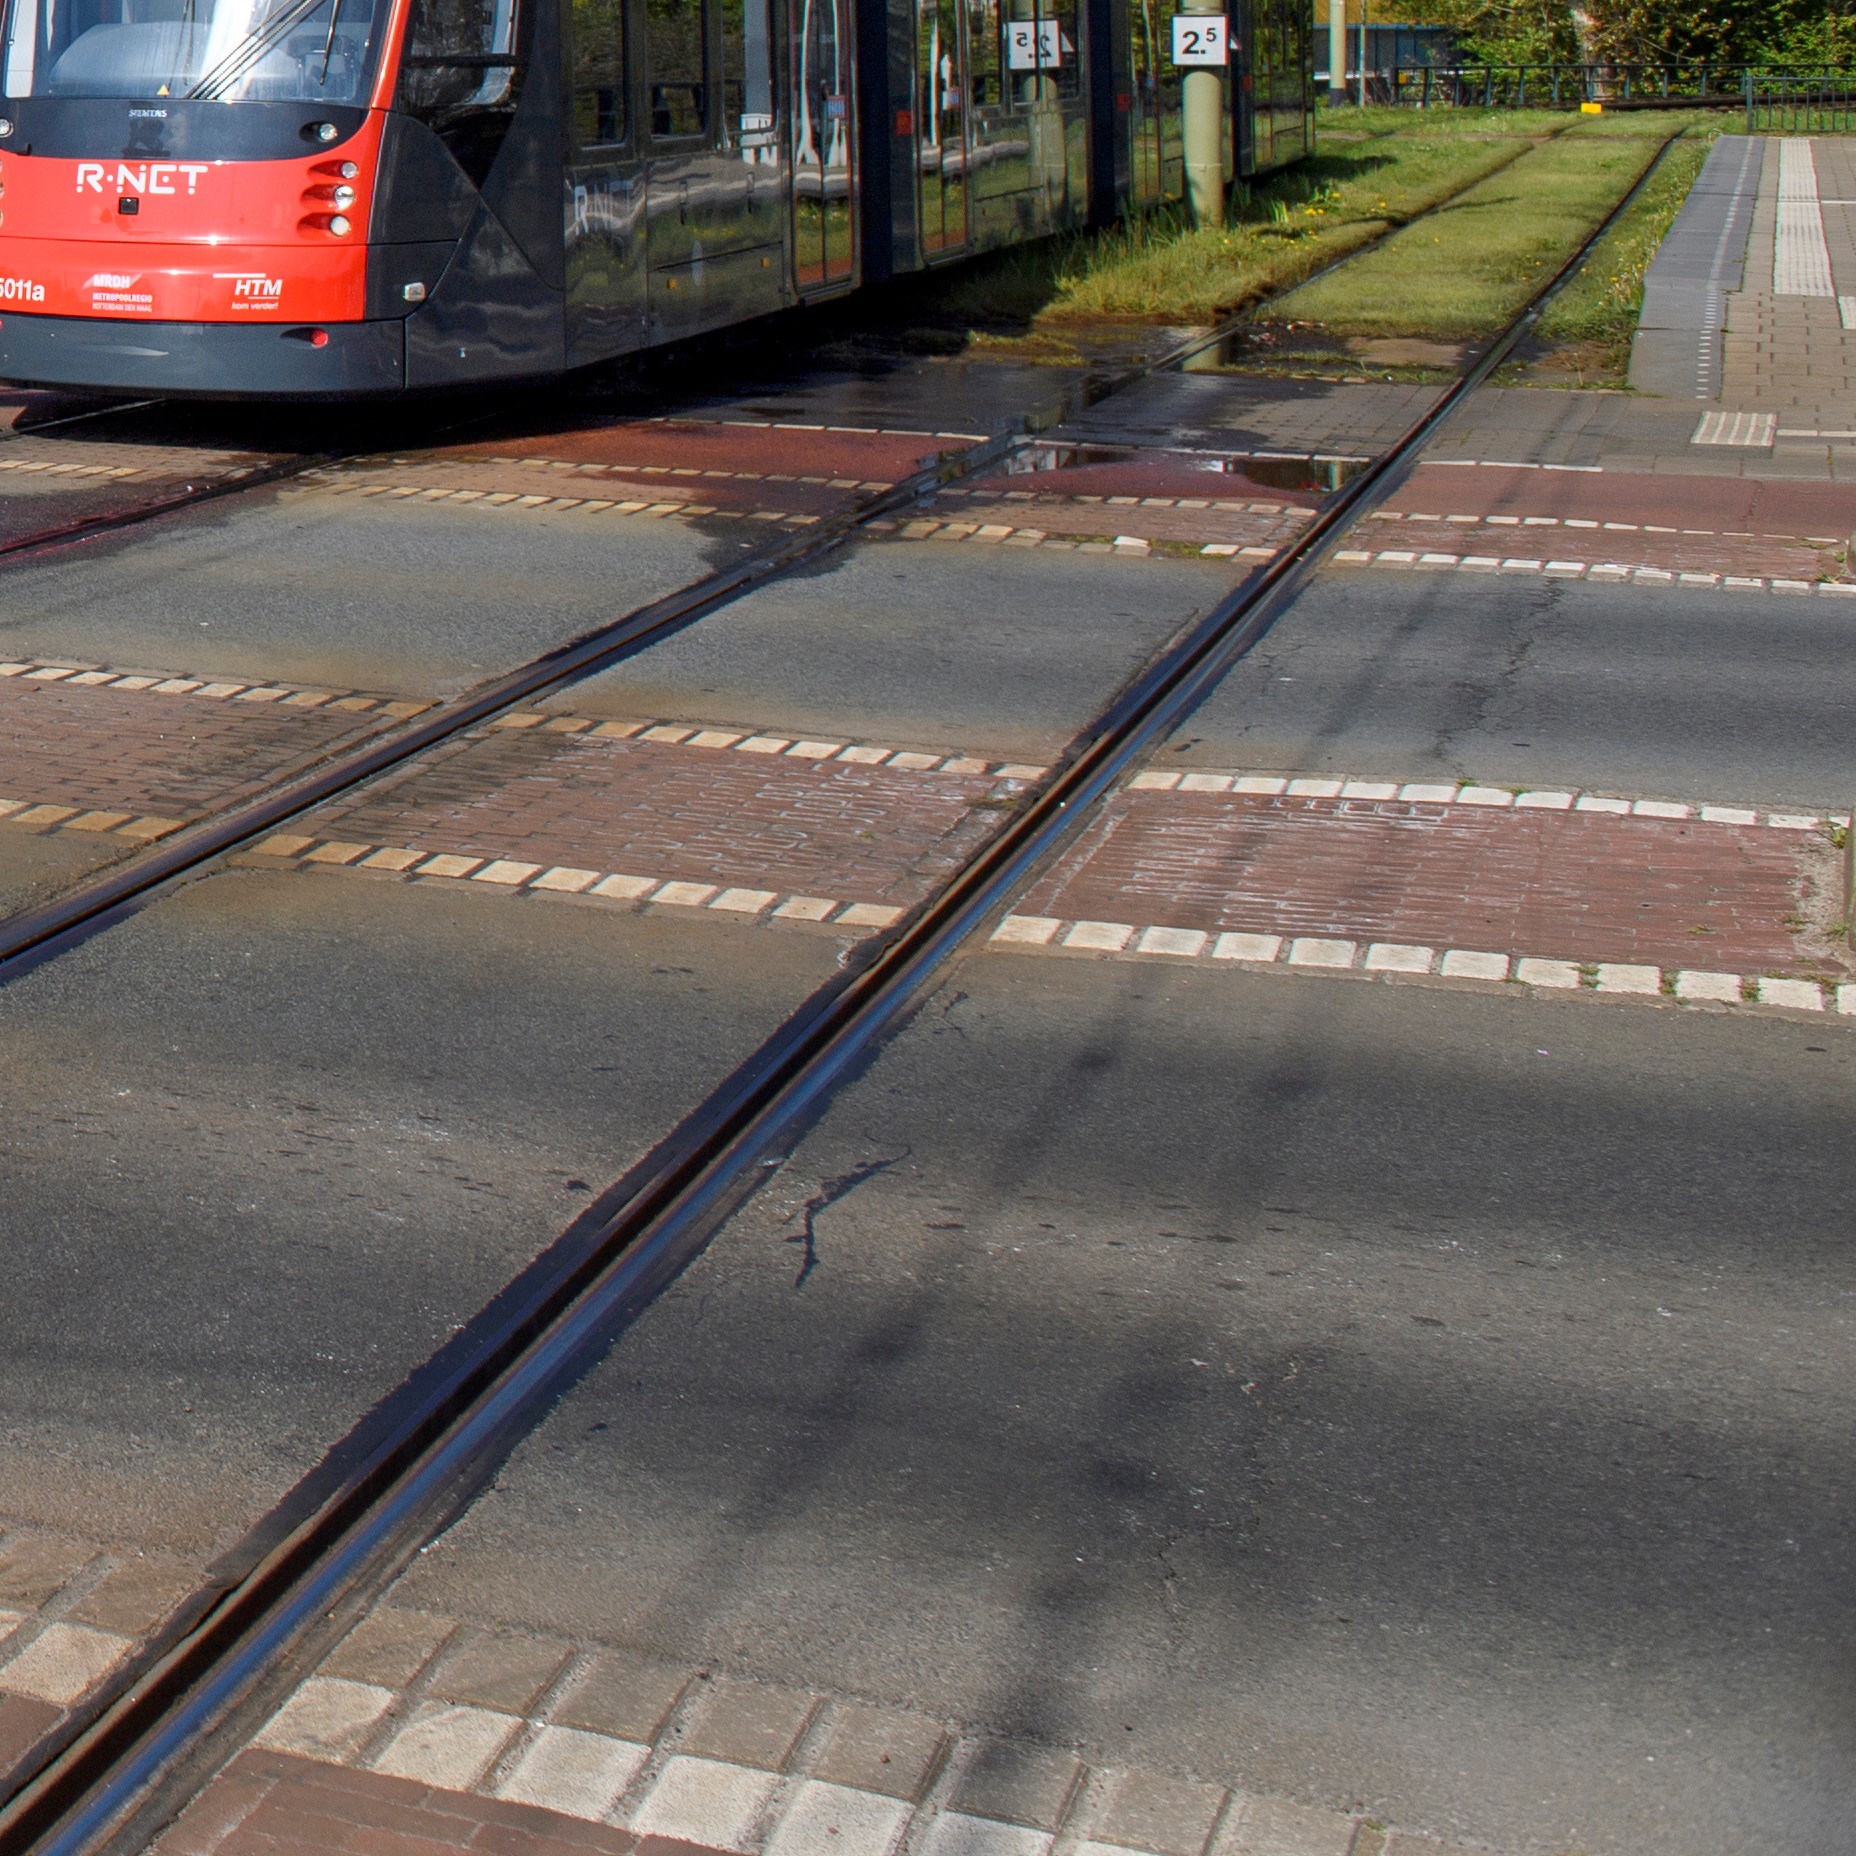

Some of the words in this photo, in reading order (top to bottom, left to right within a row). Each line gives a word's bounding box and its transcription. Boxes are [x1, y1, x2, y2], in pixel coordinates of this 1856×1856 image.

[128, 109, 168, 118] SIEMENS
[92, 274, 131, 289] MRDH
[234, 278, 283, 296] HTM
[92, 292, 153, 303] METROPOOLREGIO
[231, 301, 249, 310] kom
